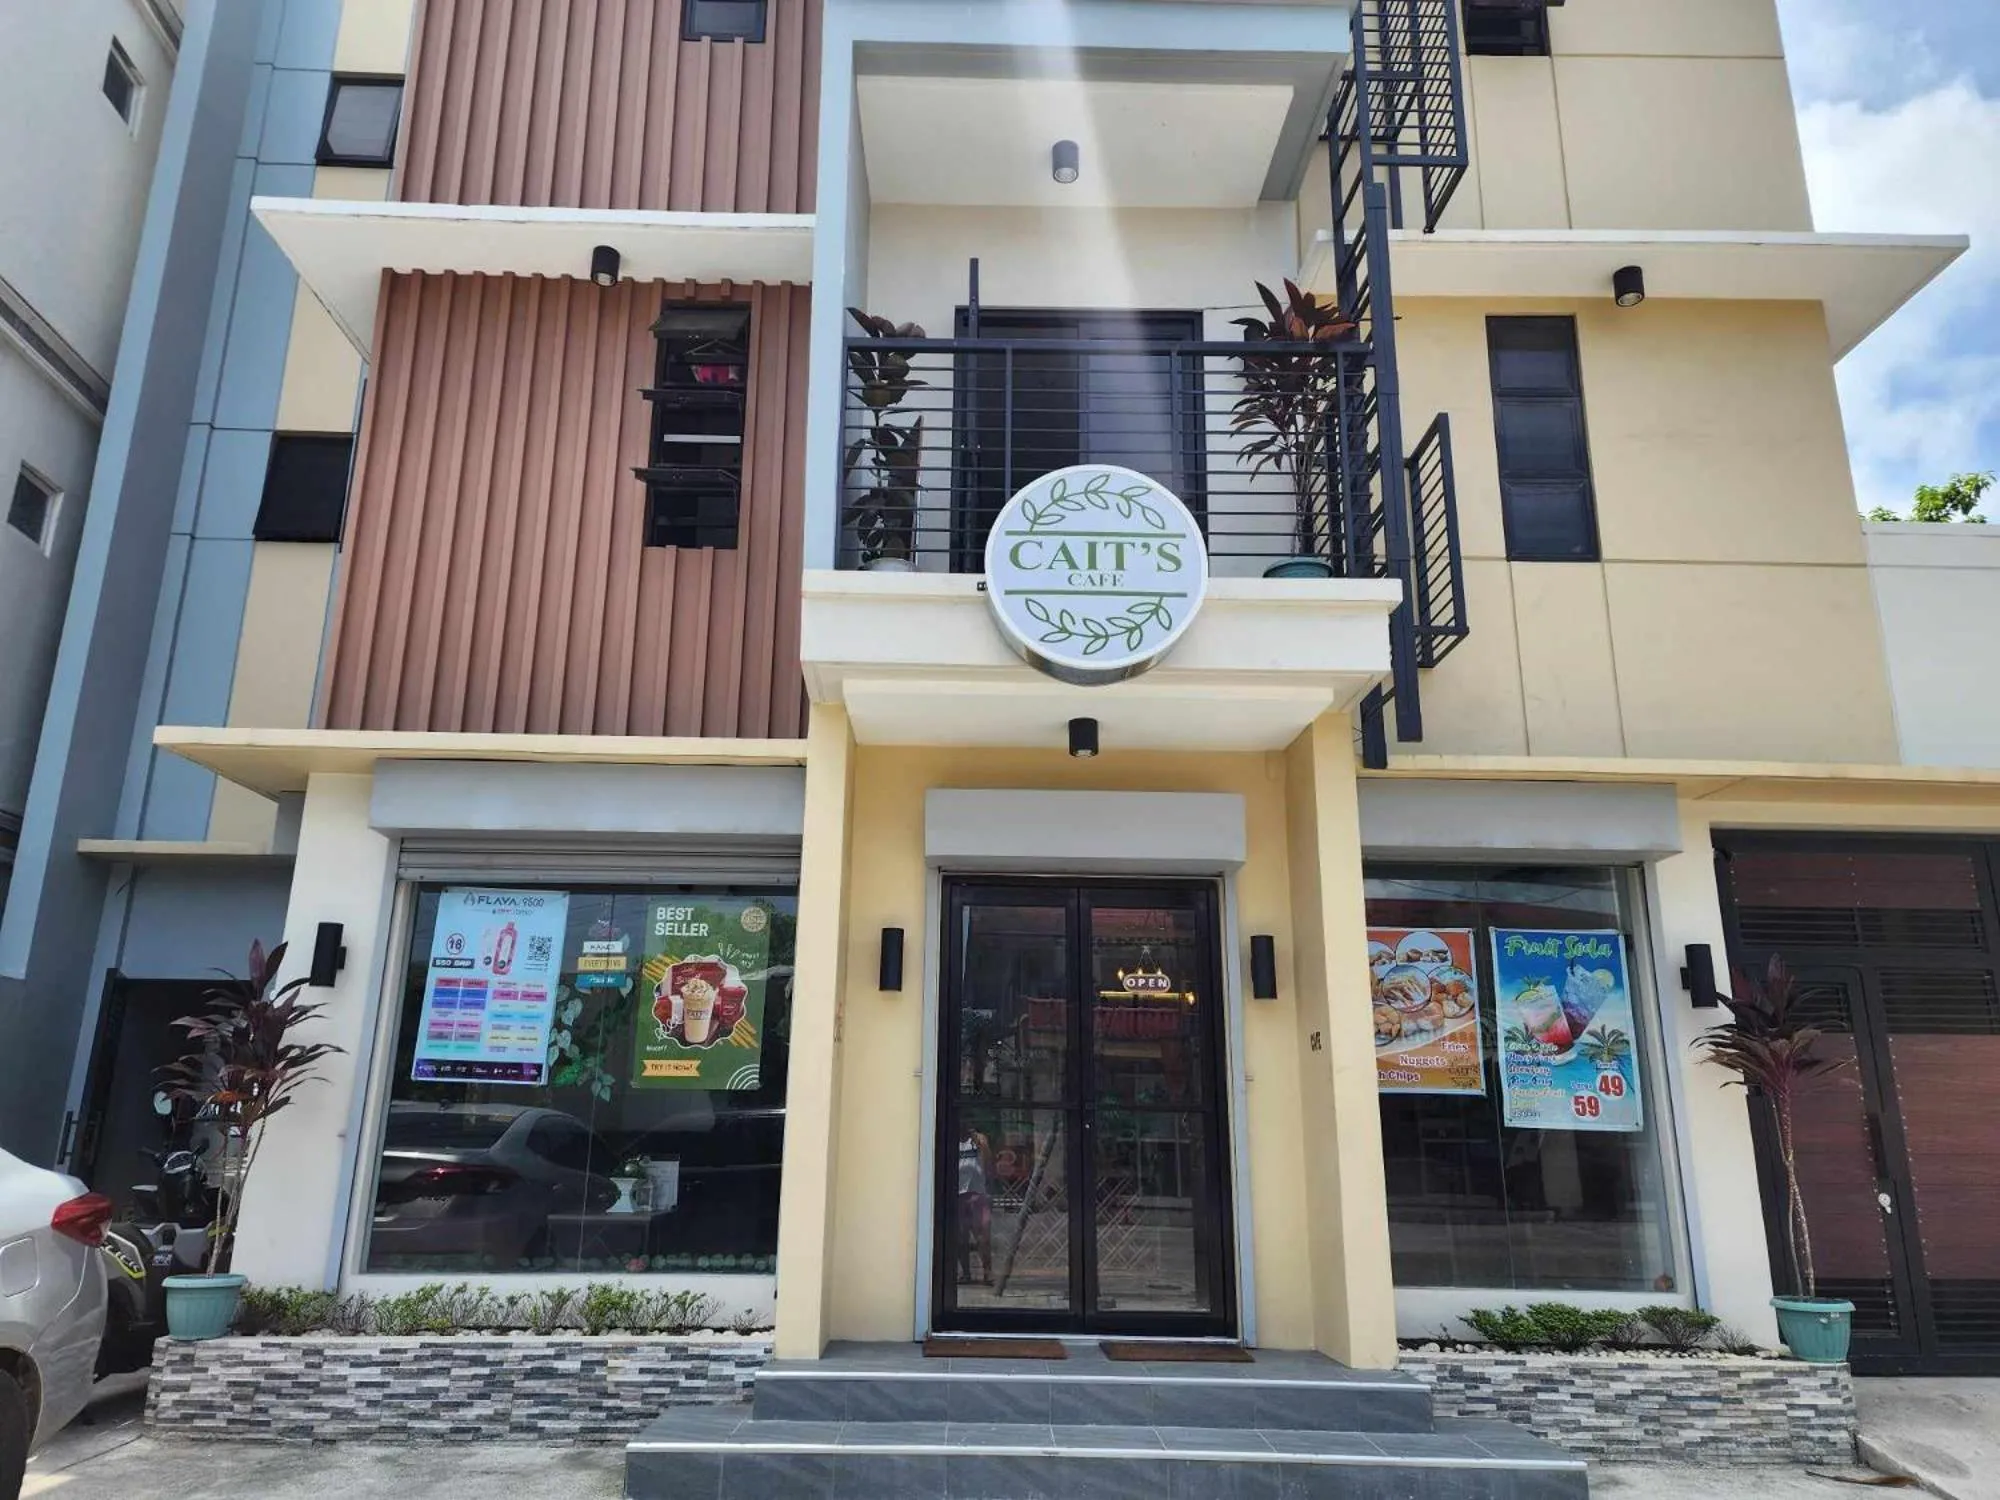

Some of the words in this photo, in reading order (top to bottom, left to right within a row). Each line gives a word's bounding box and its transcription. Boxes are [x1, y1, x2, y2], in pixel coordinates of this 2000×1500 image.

[1009, 540, 1182, 572] CAIT'S
[1067, 573, 1124, 587] CAFE
[656, 907, 695, 921] BEST
[654, 922, 709, 937] SELLER
[1505, 936, 1562, 957] Fruit
[1563, 936, 1613, 958] Soda
[1126, 978, 1168, 988] OPEN
[1441, 1042, 1469, 1052] Fries
[651, 1063, 664, 1071] TRY
[1400, 1055, 1446, 1067] Nuggets
[1388, 1070, 1420, 1082] Chips
[1598, 1075, 1624, 1097] 49
[1573, 1095, 1600, 1118] 59
